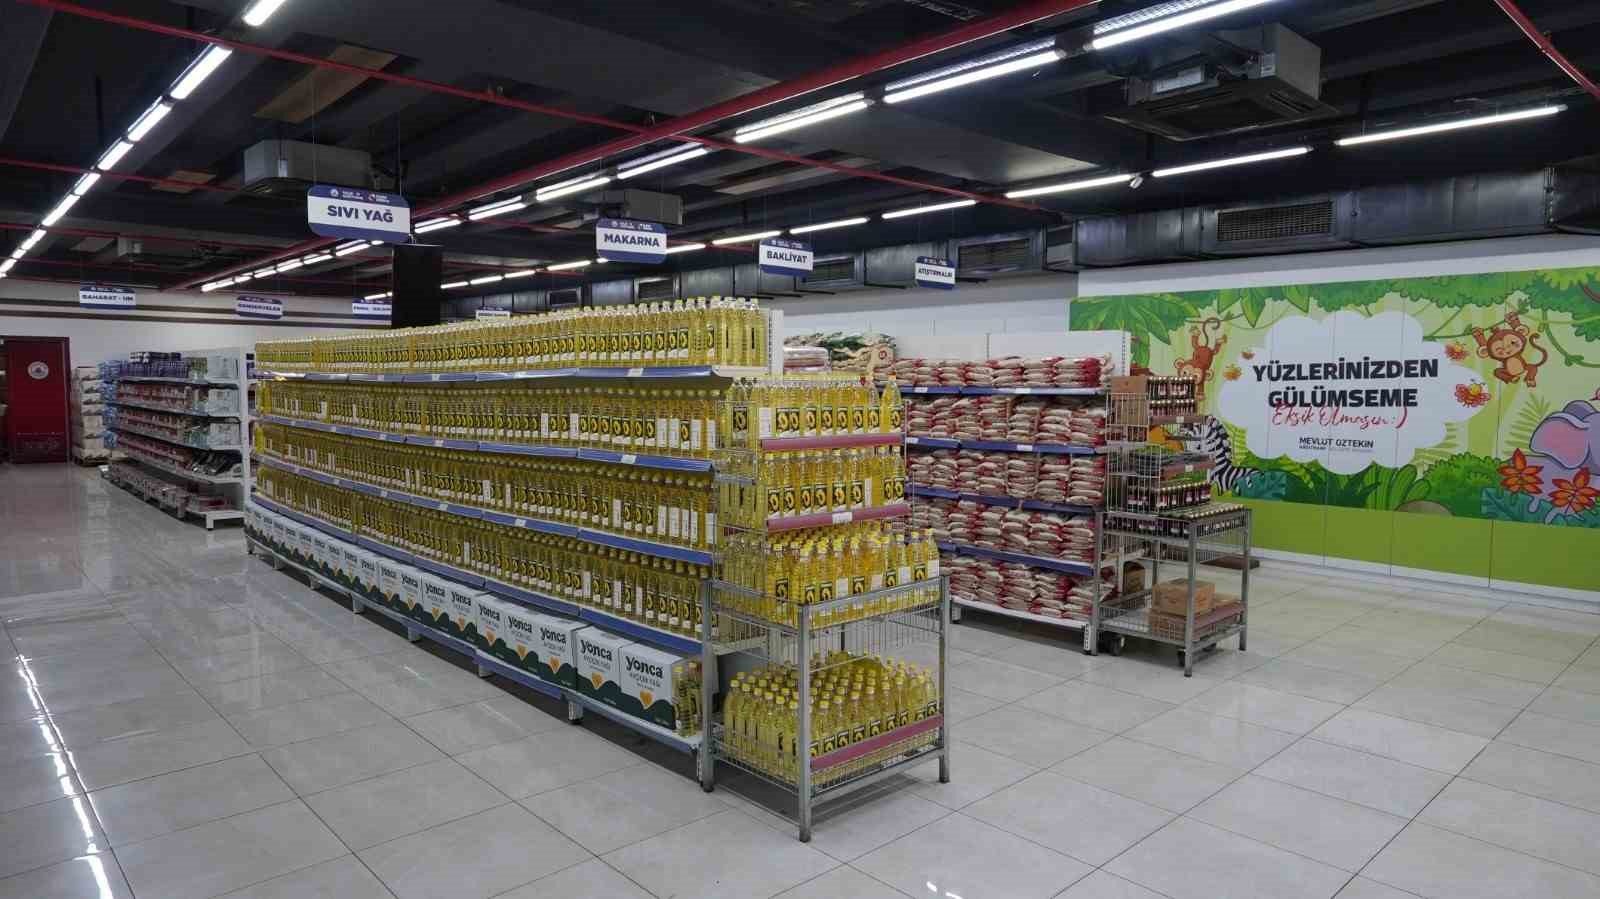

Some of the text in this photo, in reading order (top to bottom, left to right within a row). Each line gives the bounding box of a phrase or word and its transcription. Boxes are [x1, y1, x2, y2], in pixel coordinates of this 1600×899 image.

[327, 205, 394, 223] SIVI YAĞ
[603, 233, 660, 248] MAKARNA
[1252, 356, 1438, 382] YÜZLERİNİZDEN
[1268, 386, 1418, 408] GÜLÜMSEME
[425, 582, 445, 598] yonca
[451, 591, 471, 606] yonca
[478, 603, 500, 622] yonca
[507, 615, 532, 633] yonca
[540, 627, 566, 644] yonca
[580, 639, 612, 661] yonca
[625, 655, 663, 680] yonca
